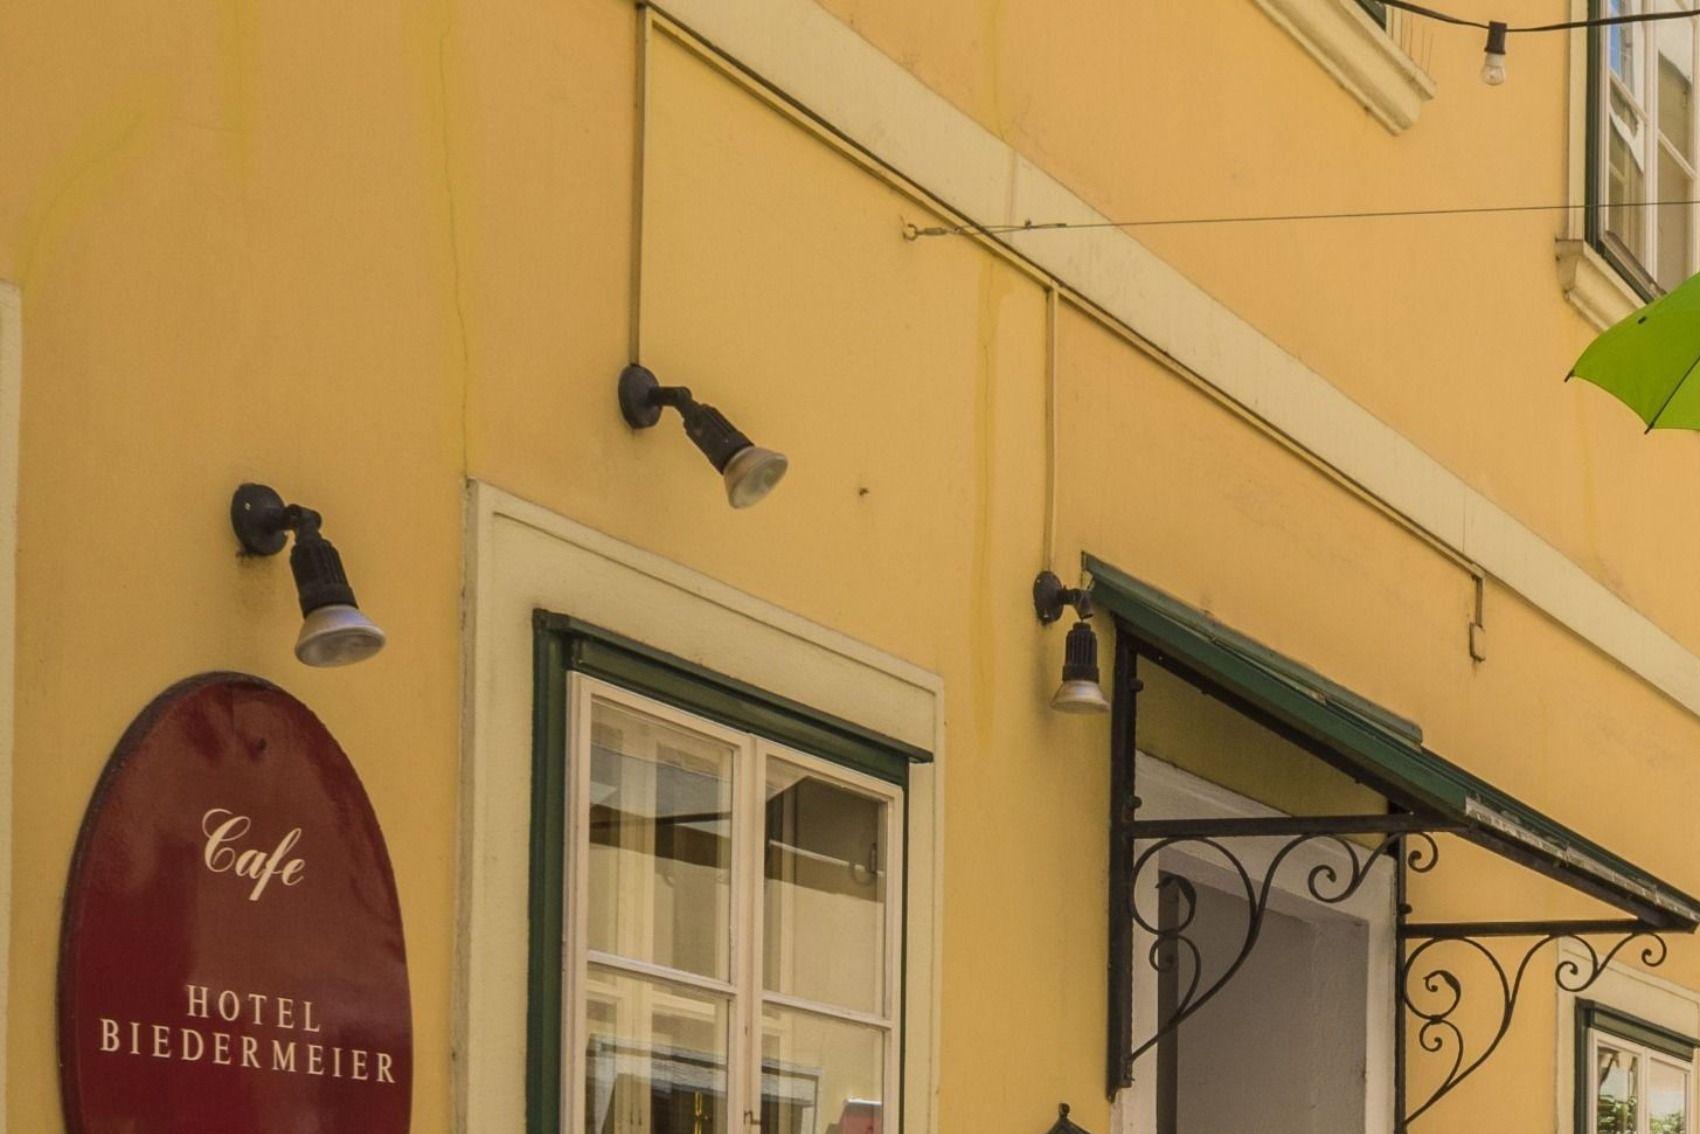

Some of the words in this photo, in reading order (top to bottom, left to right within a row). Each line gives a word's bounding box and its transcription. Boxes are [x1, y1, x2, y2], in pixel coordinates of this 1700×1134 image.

[201, 808, 305, 901] Cafe
[186, 983, 322, 1033] HOTEL
[99, 1017, 397, 1084] BIEDERMEIER
